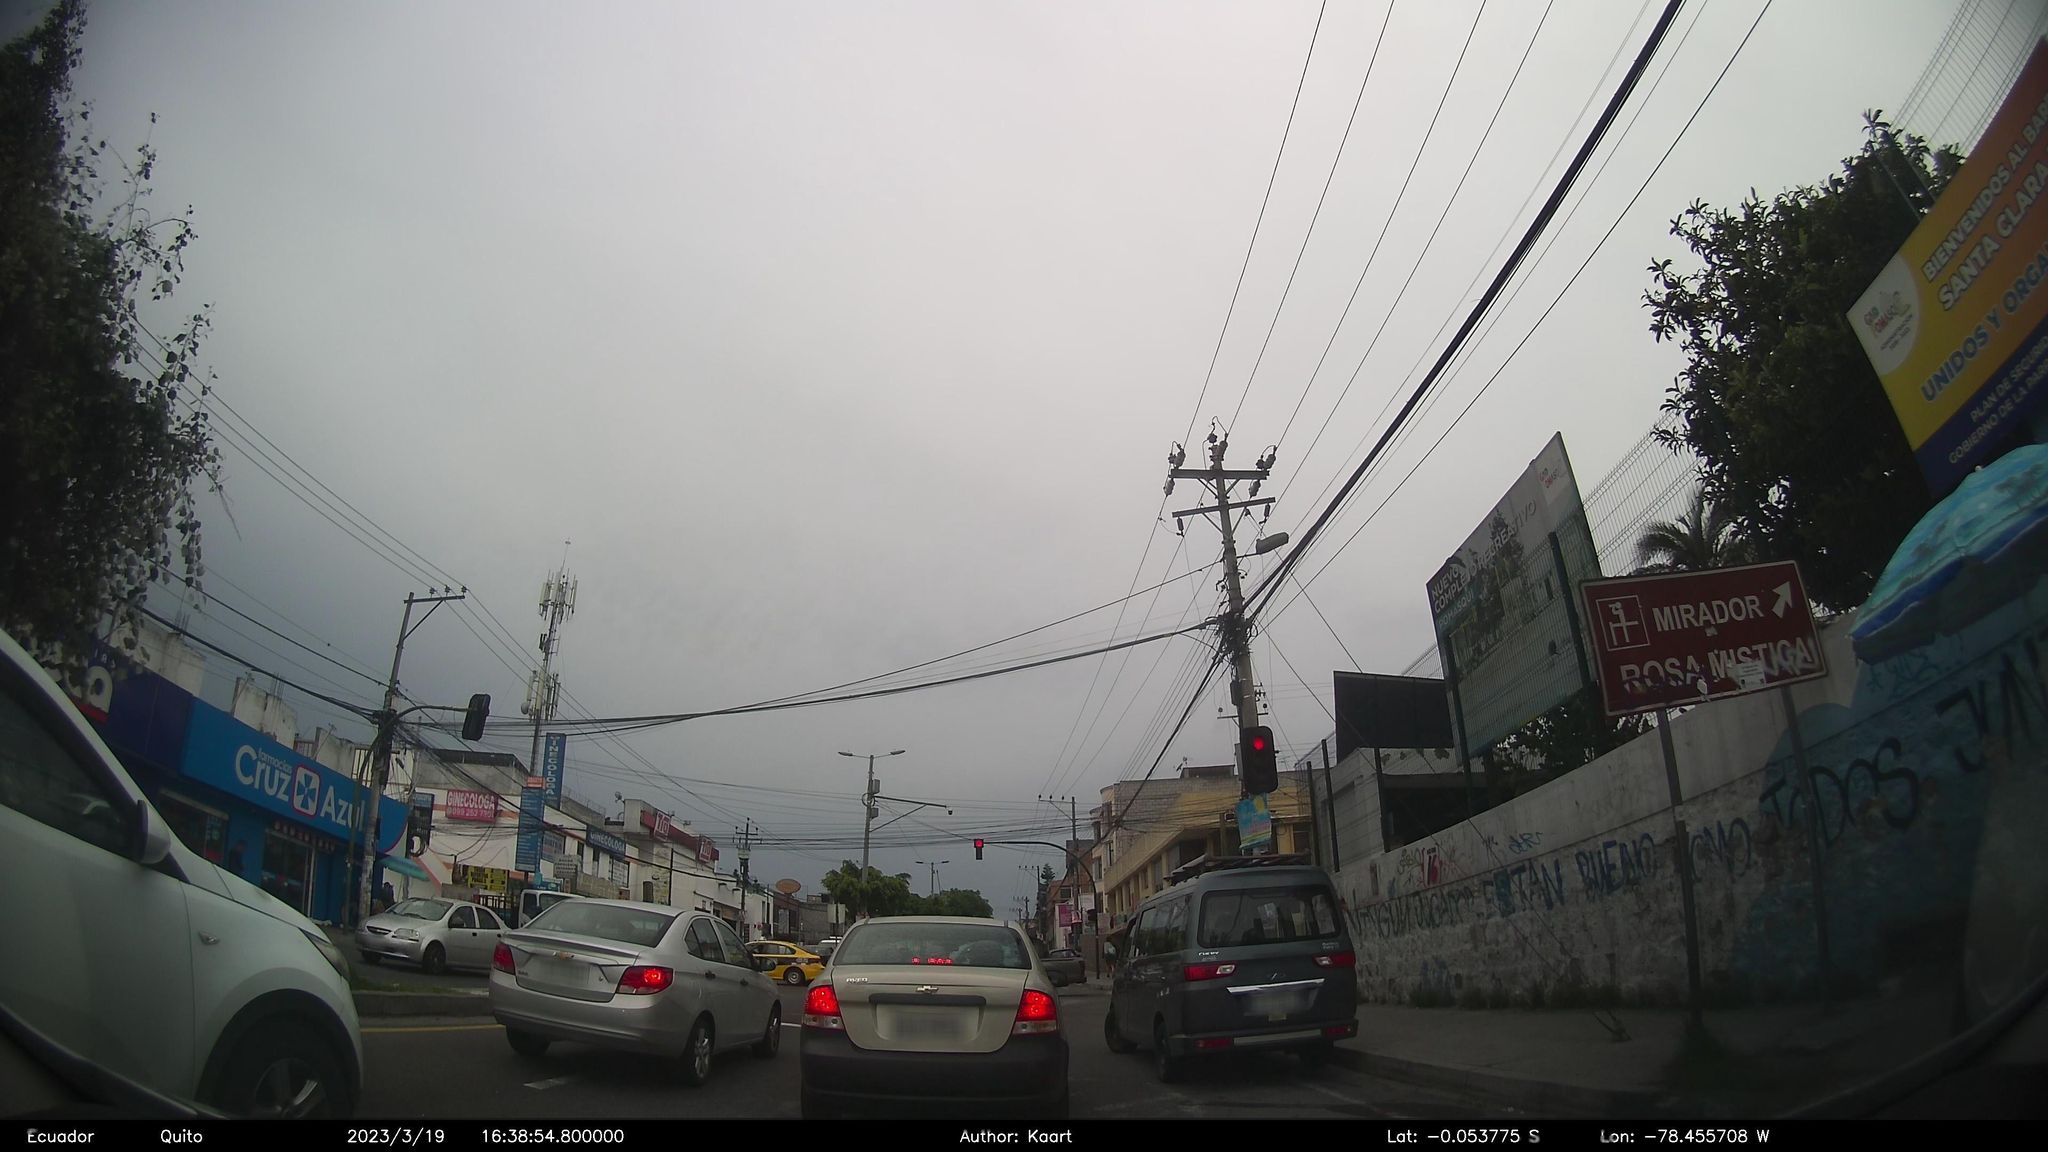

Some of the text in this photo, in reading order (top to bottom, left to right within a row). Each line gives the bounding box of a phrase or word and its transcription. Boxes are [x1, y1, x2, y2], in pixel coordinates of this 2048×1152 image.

[1922, 92, 2048, 283] BIENVENIDOS AL BAR
[1938, 160, 2048, 312] SANTA CLARA
[1920, 241, 2048, 402] UNIDOS Y ORGA
[1948, 413, 1999, 464] GOBIERNO
[1997, 398, 2014, 418] DE
[2011, 386, 2029, 404] LA
[1969, 391, 1998, 423] PLAN
[1995, 376, 2012, 395] DE
[1432, 566, 1460, 601] NUEVO
[1434, 498, 1538, 614] COMPLEJO RECREATIVO
[1652, 594, 1765, 633] MIRADOR
[1620, 654, 1706, 693] ROSA
[235, 744, 366, 832] Cruz Azul
[447, 791, 495, 811] GINECOLOGA
